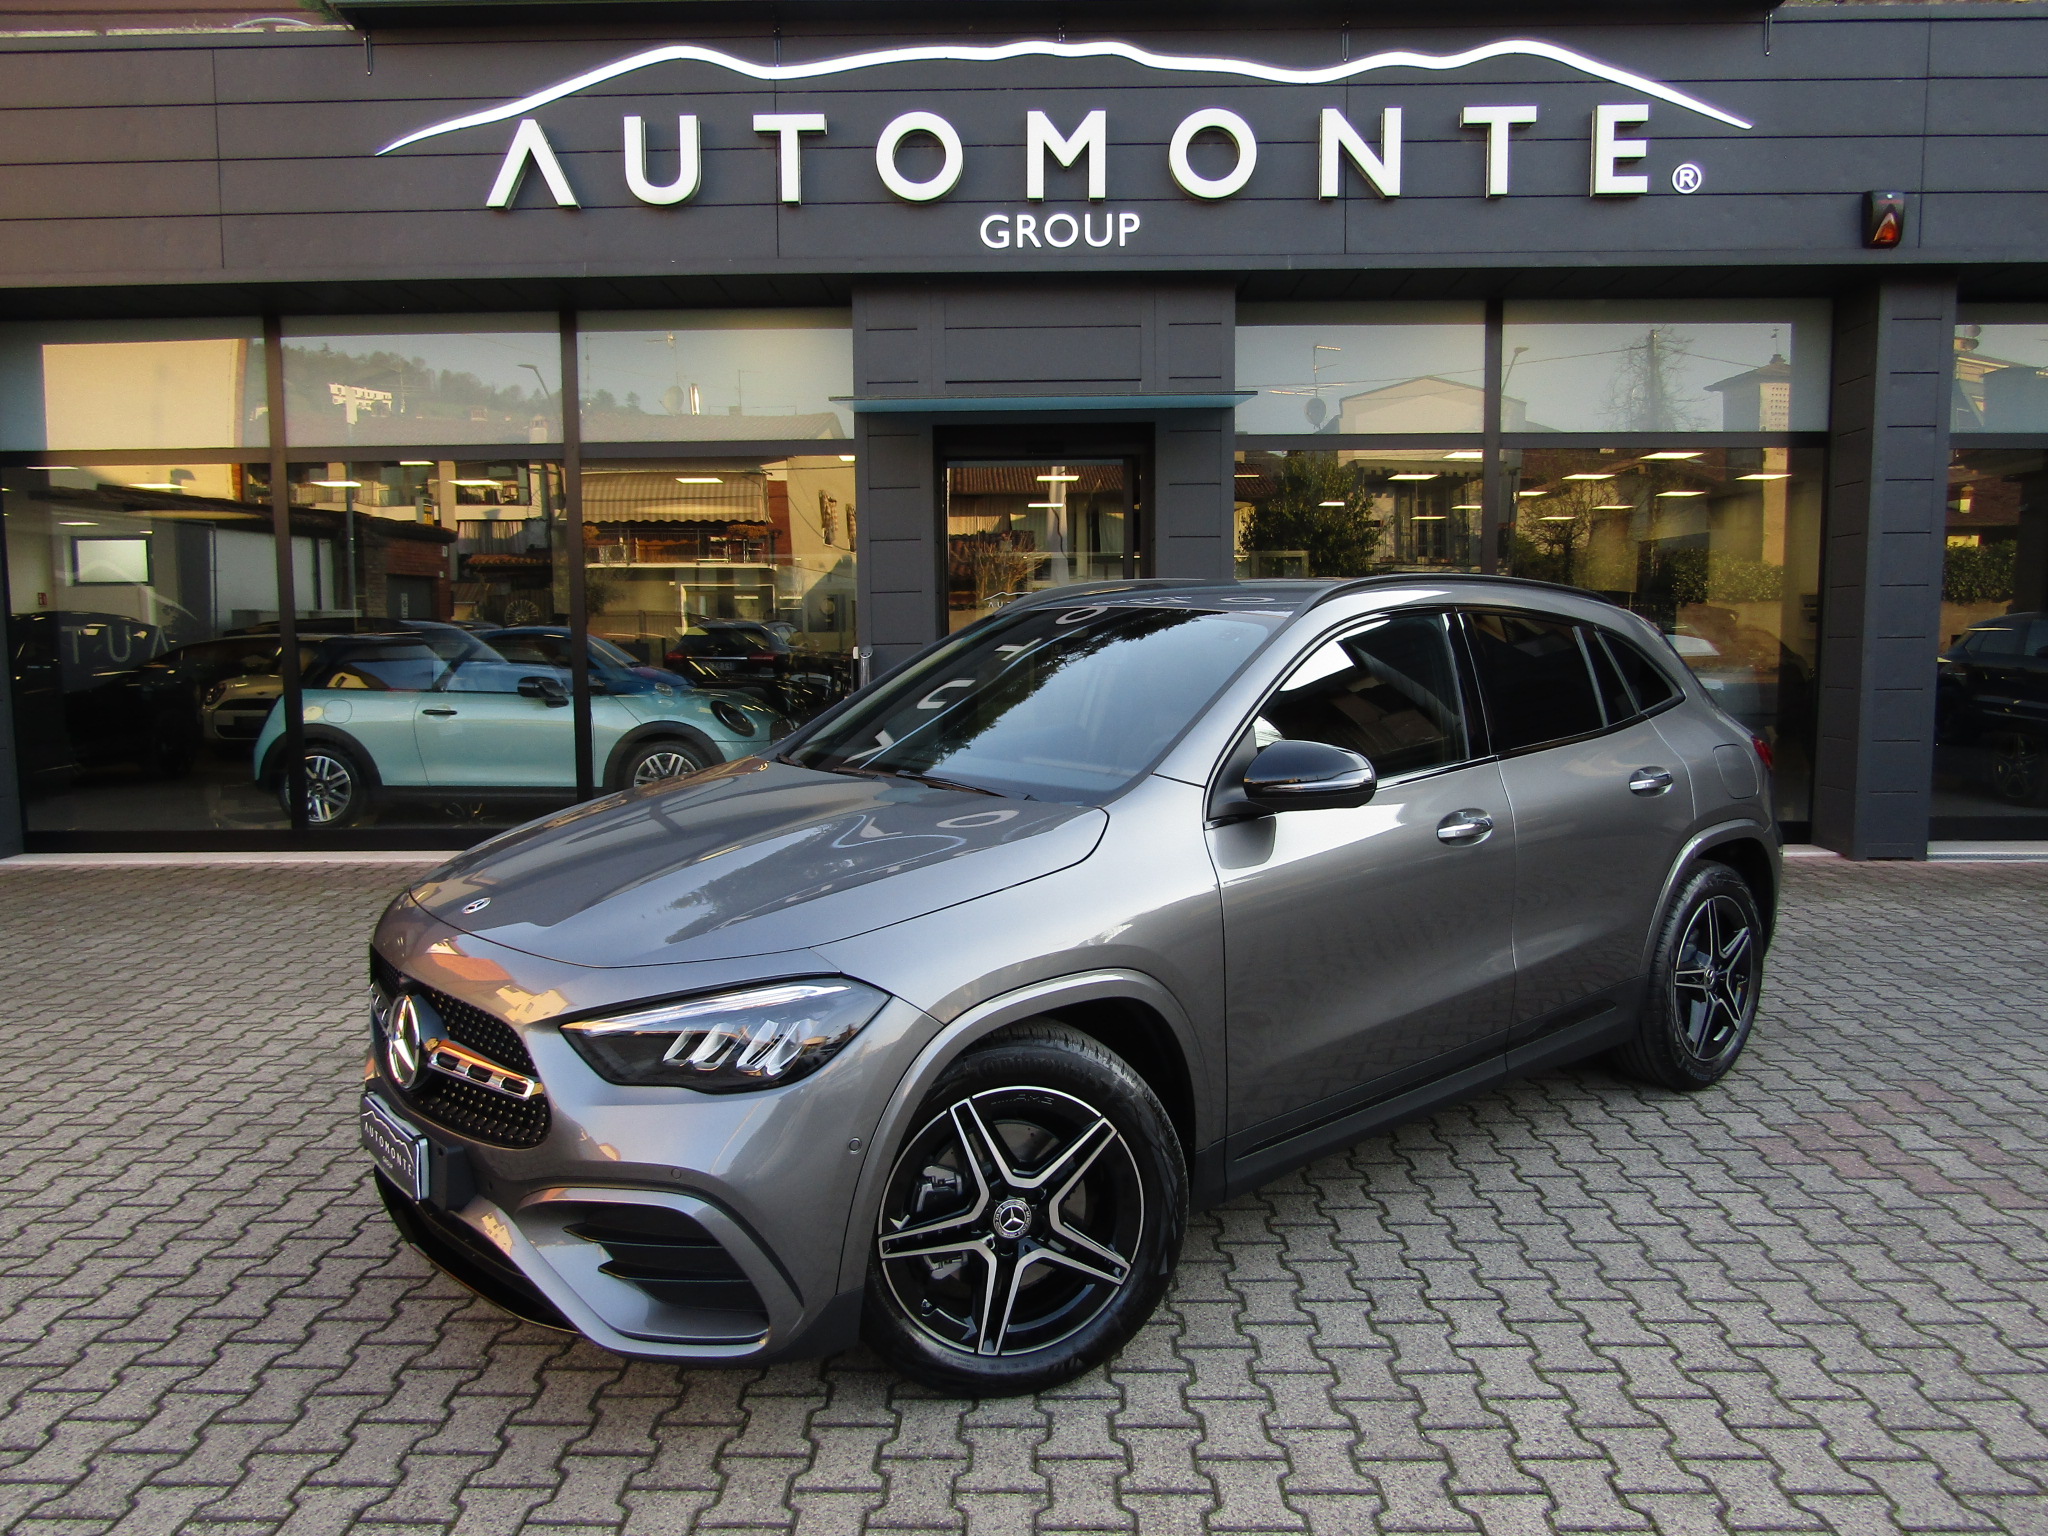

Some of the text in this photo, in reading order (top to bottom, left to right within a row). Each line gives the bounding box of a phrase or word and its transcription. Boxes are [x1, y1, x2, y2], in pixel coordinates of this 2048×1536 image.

[486, 103, 1650, 208] AUTOMONTE
[980, 212, 1141, 250] GROUP
[364, 1121, 412, 1176] AUTOMONTE
